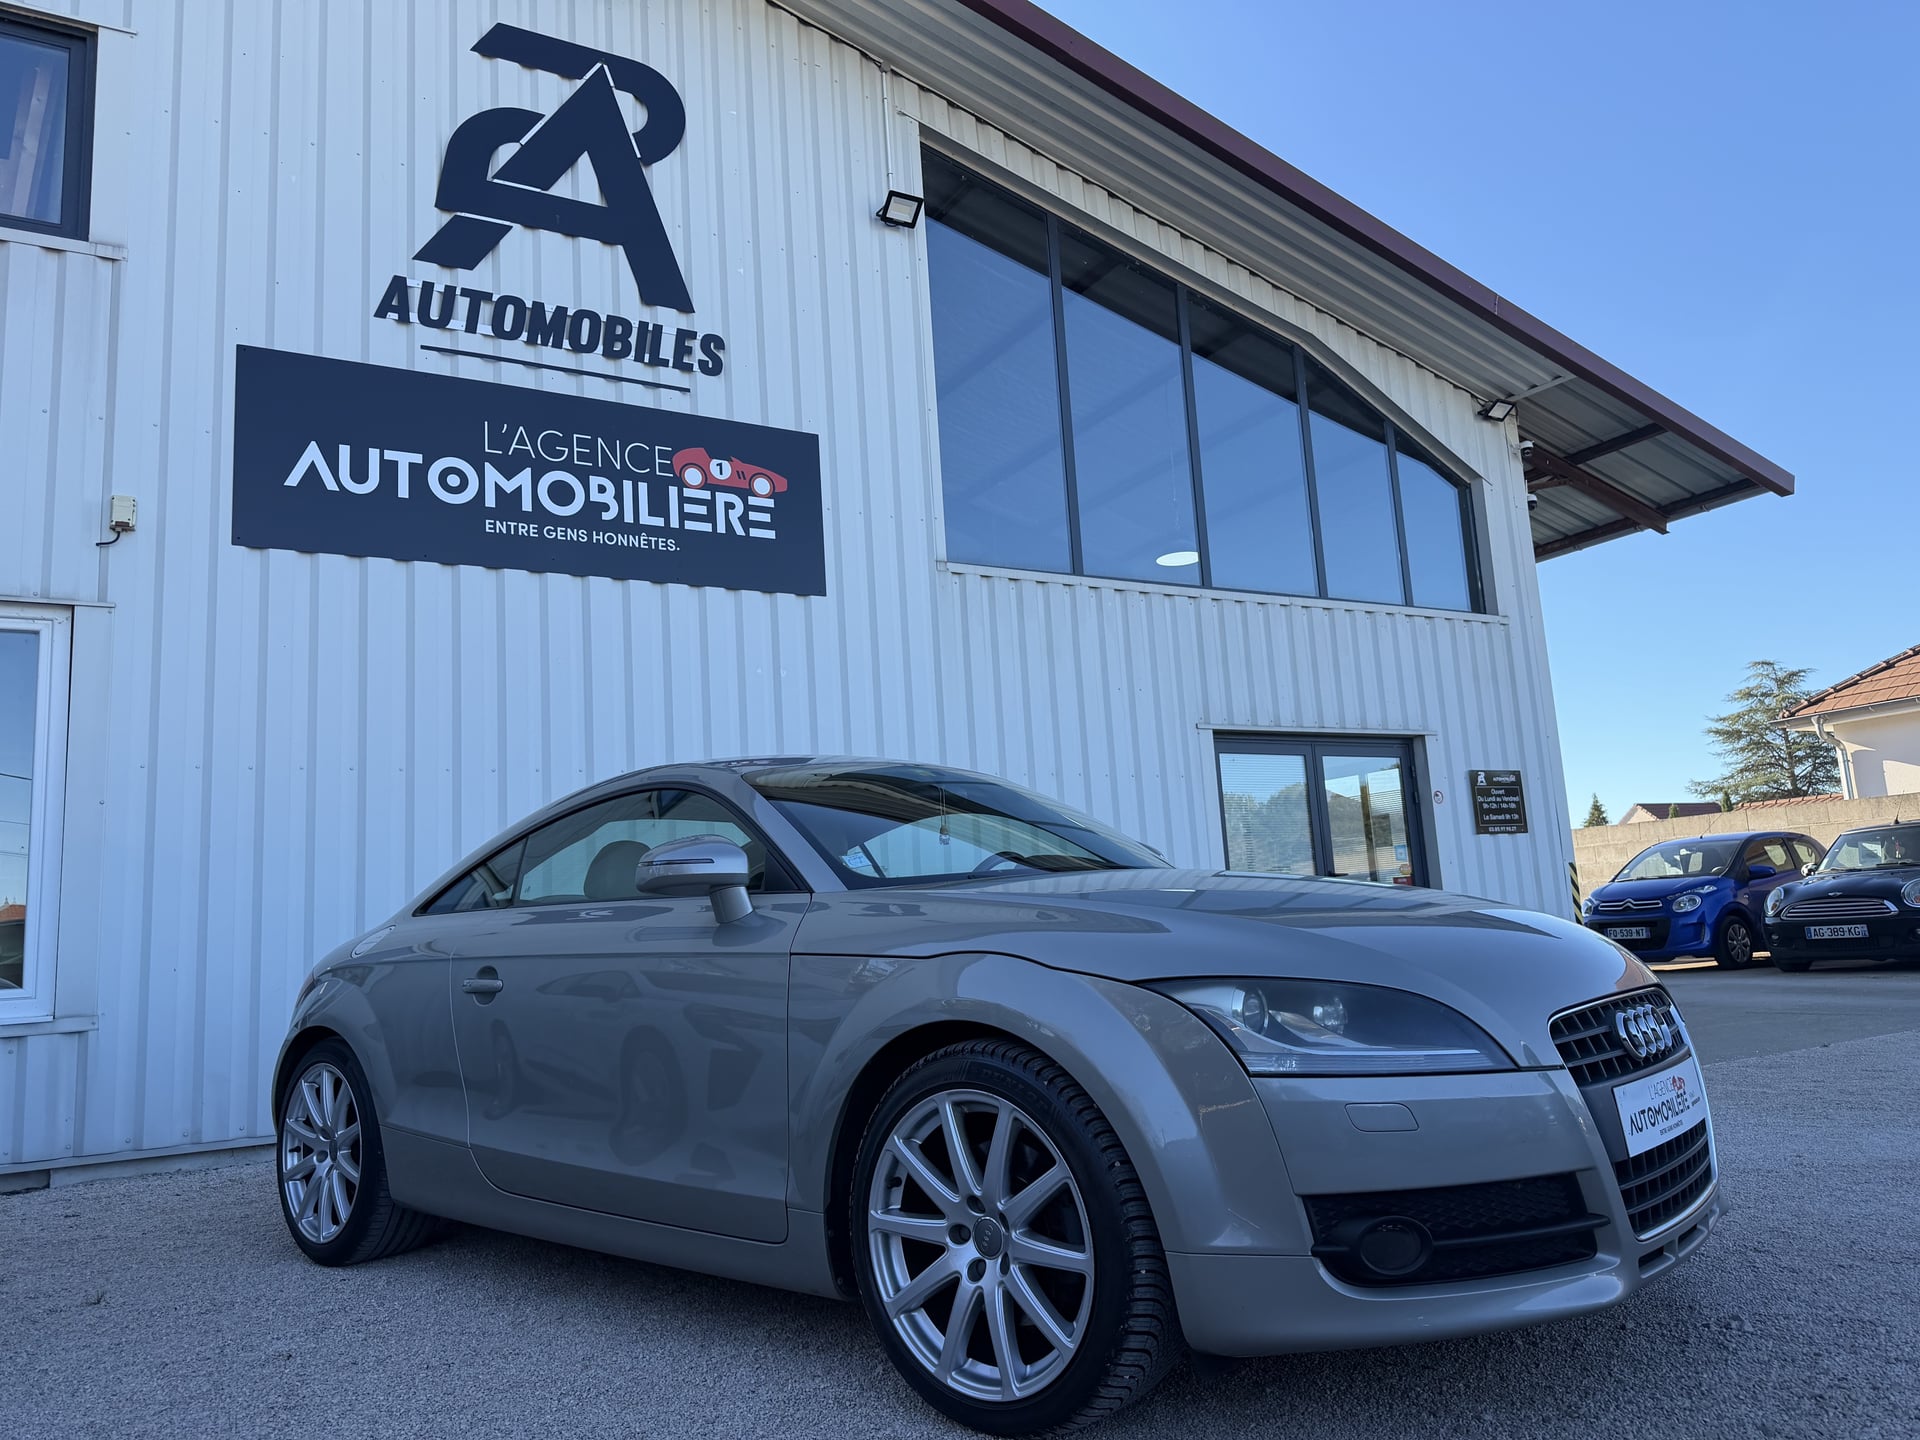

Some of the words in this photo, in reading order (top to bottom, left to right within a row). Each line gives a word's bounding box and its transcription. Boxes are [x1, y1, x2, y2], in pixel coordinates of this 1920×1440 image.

[373, 274, 726, 377] AUTOMOBILES
[484, 420, 674, 477] L'AGENCE
[716, 462, 724, 476] 1
[485, 519, 539, 537] ENTRE
[543, 525, 588, 543] GENS
[592, 531, 681, 552] HONNÊTES.
